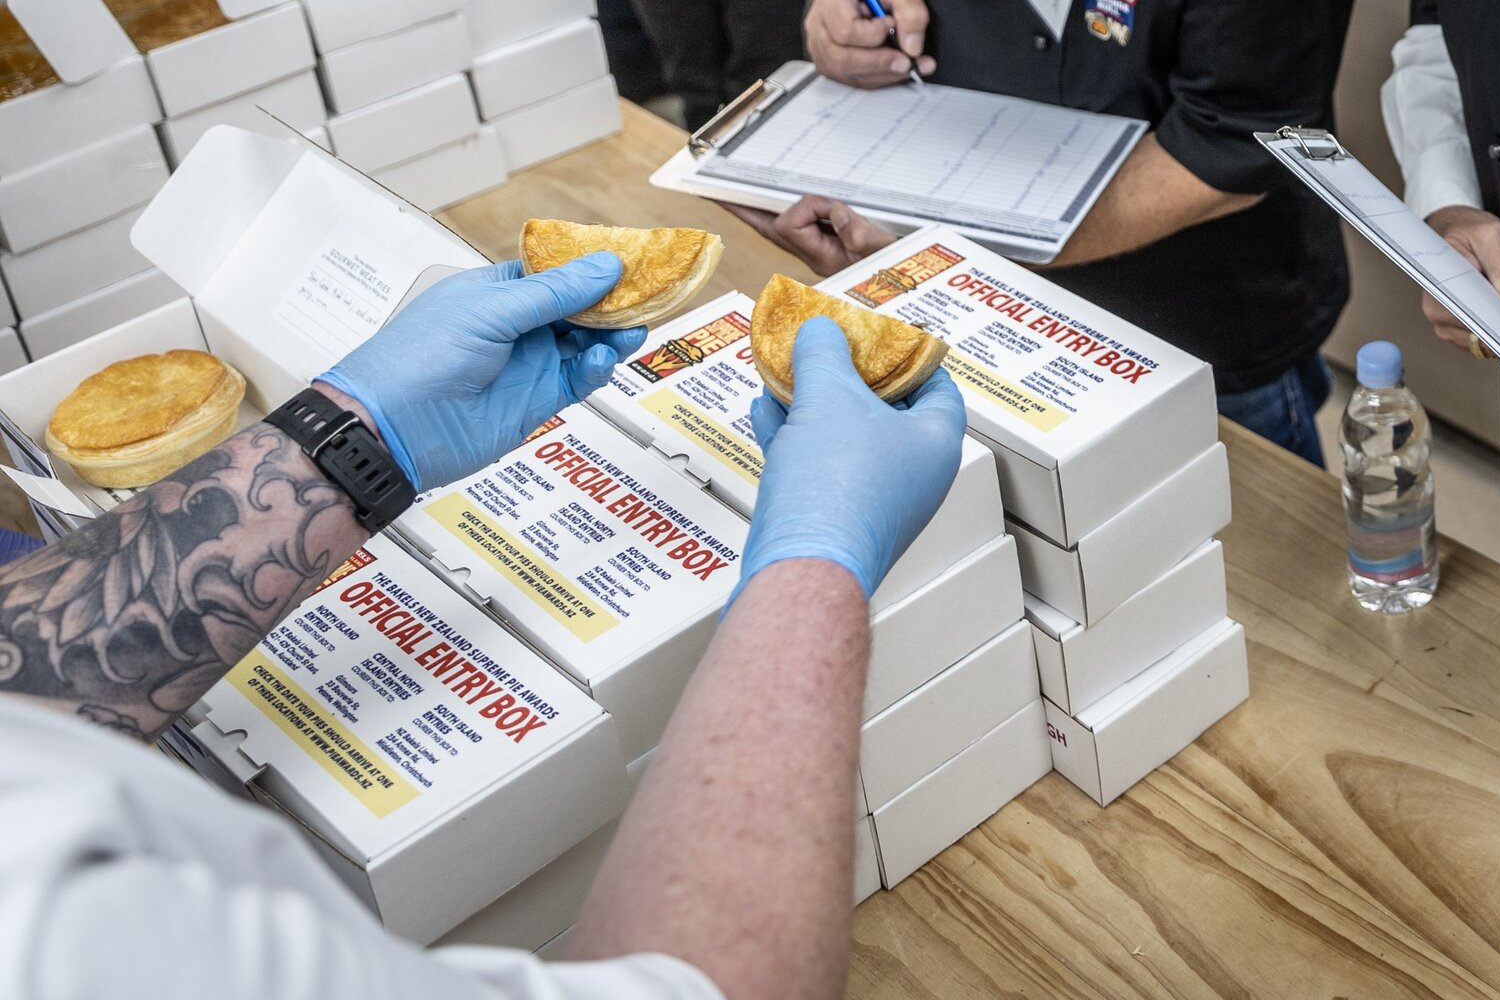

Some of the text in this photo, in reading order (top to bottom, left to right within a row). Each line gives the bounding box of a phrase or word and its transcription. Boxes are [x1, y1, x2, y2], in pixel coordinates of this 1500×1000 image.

[893, 258, 939, 283] PIE
[947, 274, 1153, 384] OFFICIAL ENTRY BOX
[971, 267, 1160, 369] THE BAKELS NEW ZEALAND SUPREME PIE AWARDS
[683, 328, 729, 356] PIE
[1049, 360, 1077, 377] ENTRIES
[1056, 356, 1104, 383] SOUTH ISLAND
[1000, 385, 1023, 400] ARRIVE
[1031, 403, 1046, 413] ONE
[674, 404, 745, 454] CHECK THE DATE YOUR PIES
[503, 466, 529, 485] ENTRIES
[515, 461, 555, 492] NORTH ISLAND
[535, 441, 729, 581] OFFICIAL ENTRY BOX
[563, 433, 739, 561] THE BAKELS NEW ZEALAND SUPREME PIE AWARDS
[558, 507, 606, 543] ISLAND ENTRIES
[568, 502, 617, 538] CENTRAL NORTH
[462, 511, 596, 618] CHECK THE DATE YOUR PIES SHOULD ARRIVE AT ONE
[465, 527, 485, 543] THESE
[480, 540, 514, 566] LOCATIONS
[509, 564, 521, 572] AT
[517, 569, 577, 618] WWW.PIEAWARDS.NZ
[616, 552, 644, 573] ENTRIES
[625, 546, 672, 580] SOUTH ISLAND
[304, 611, 332, 633] ENTRIES
[315, 605, 360, 641] NORTH ISLAND
[279, 626, 319, 659] NZ Bakels Limited
[286, 646, 305, 662] Church
[305, 663, 319, 675] East,
[372, 572, 559, 720] THE BAKELS NEW ZEALAND SUPREME PIE AWARDS
[277, 652, 301, 671] Auckland
[339, 582, 547, 744] OFFICIAL ENTRY BOX
[360, 658, 412, 700] ISLAND ENTRIES
[373, 653, 425, 695] CENTRAL NORTH
[325, 680, 360, 711] 33 Bouverie St,
[335, 675, 358, 695] Gilmours
[316, 685, 359, 724] Petone, Wellington
[247, 678, 373, 789] OF THESE LOCATIONS AT WWW.PIEAWARDS.NZ
[253, 665, 394, 789] CHECK THE DATE YOUR PIES SHOULD ARRIVE AT ONE
[422, 711, 453, 735] ENTRIES
[433, 704, 483, 743] SOUTH ISLAND
[376, 739, 433, 788] Middleton, Christchurch
[385, 733, 421, 764] 234 Annex Rd,
[395, 727, 440, 764] NZ Bakels Limited
